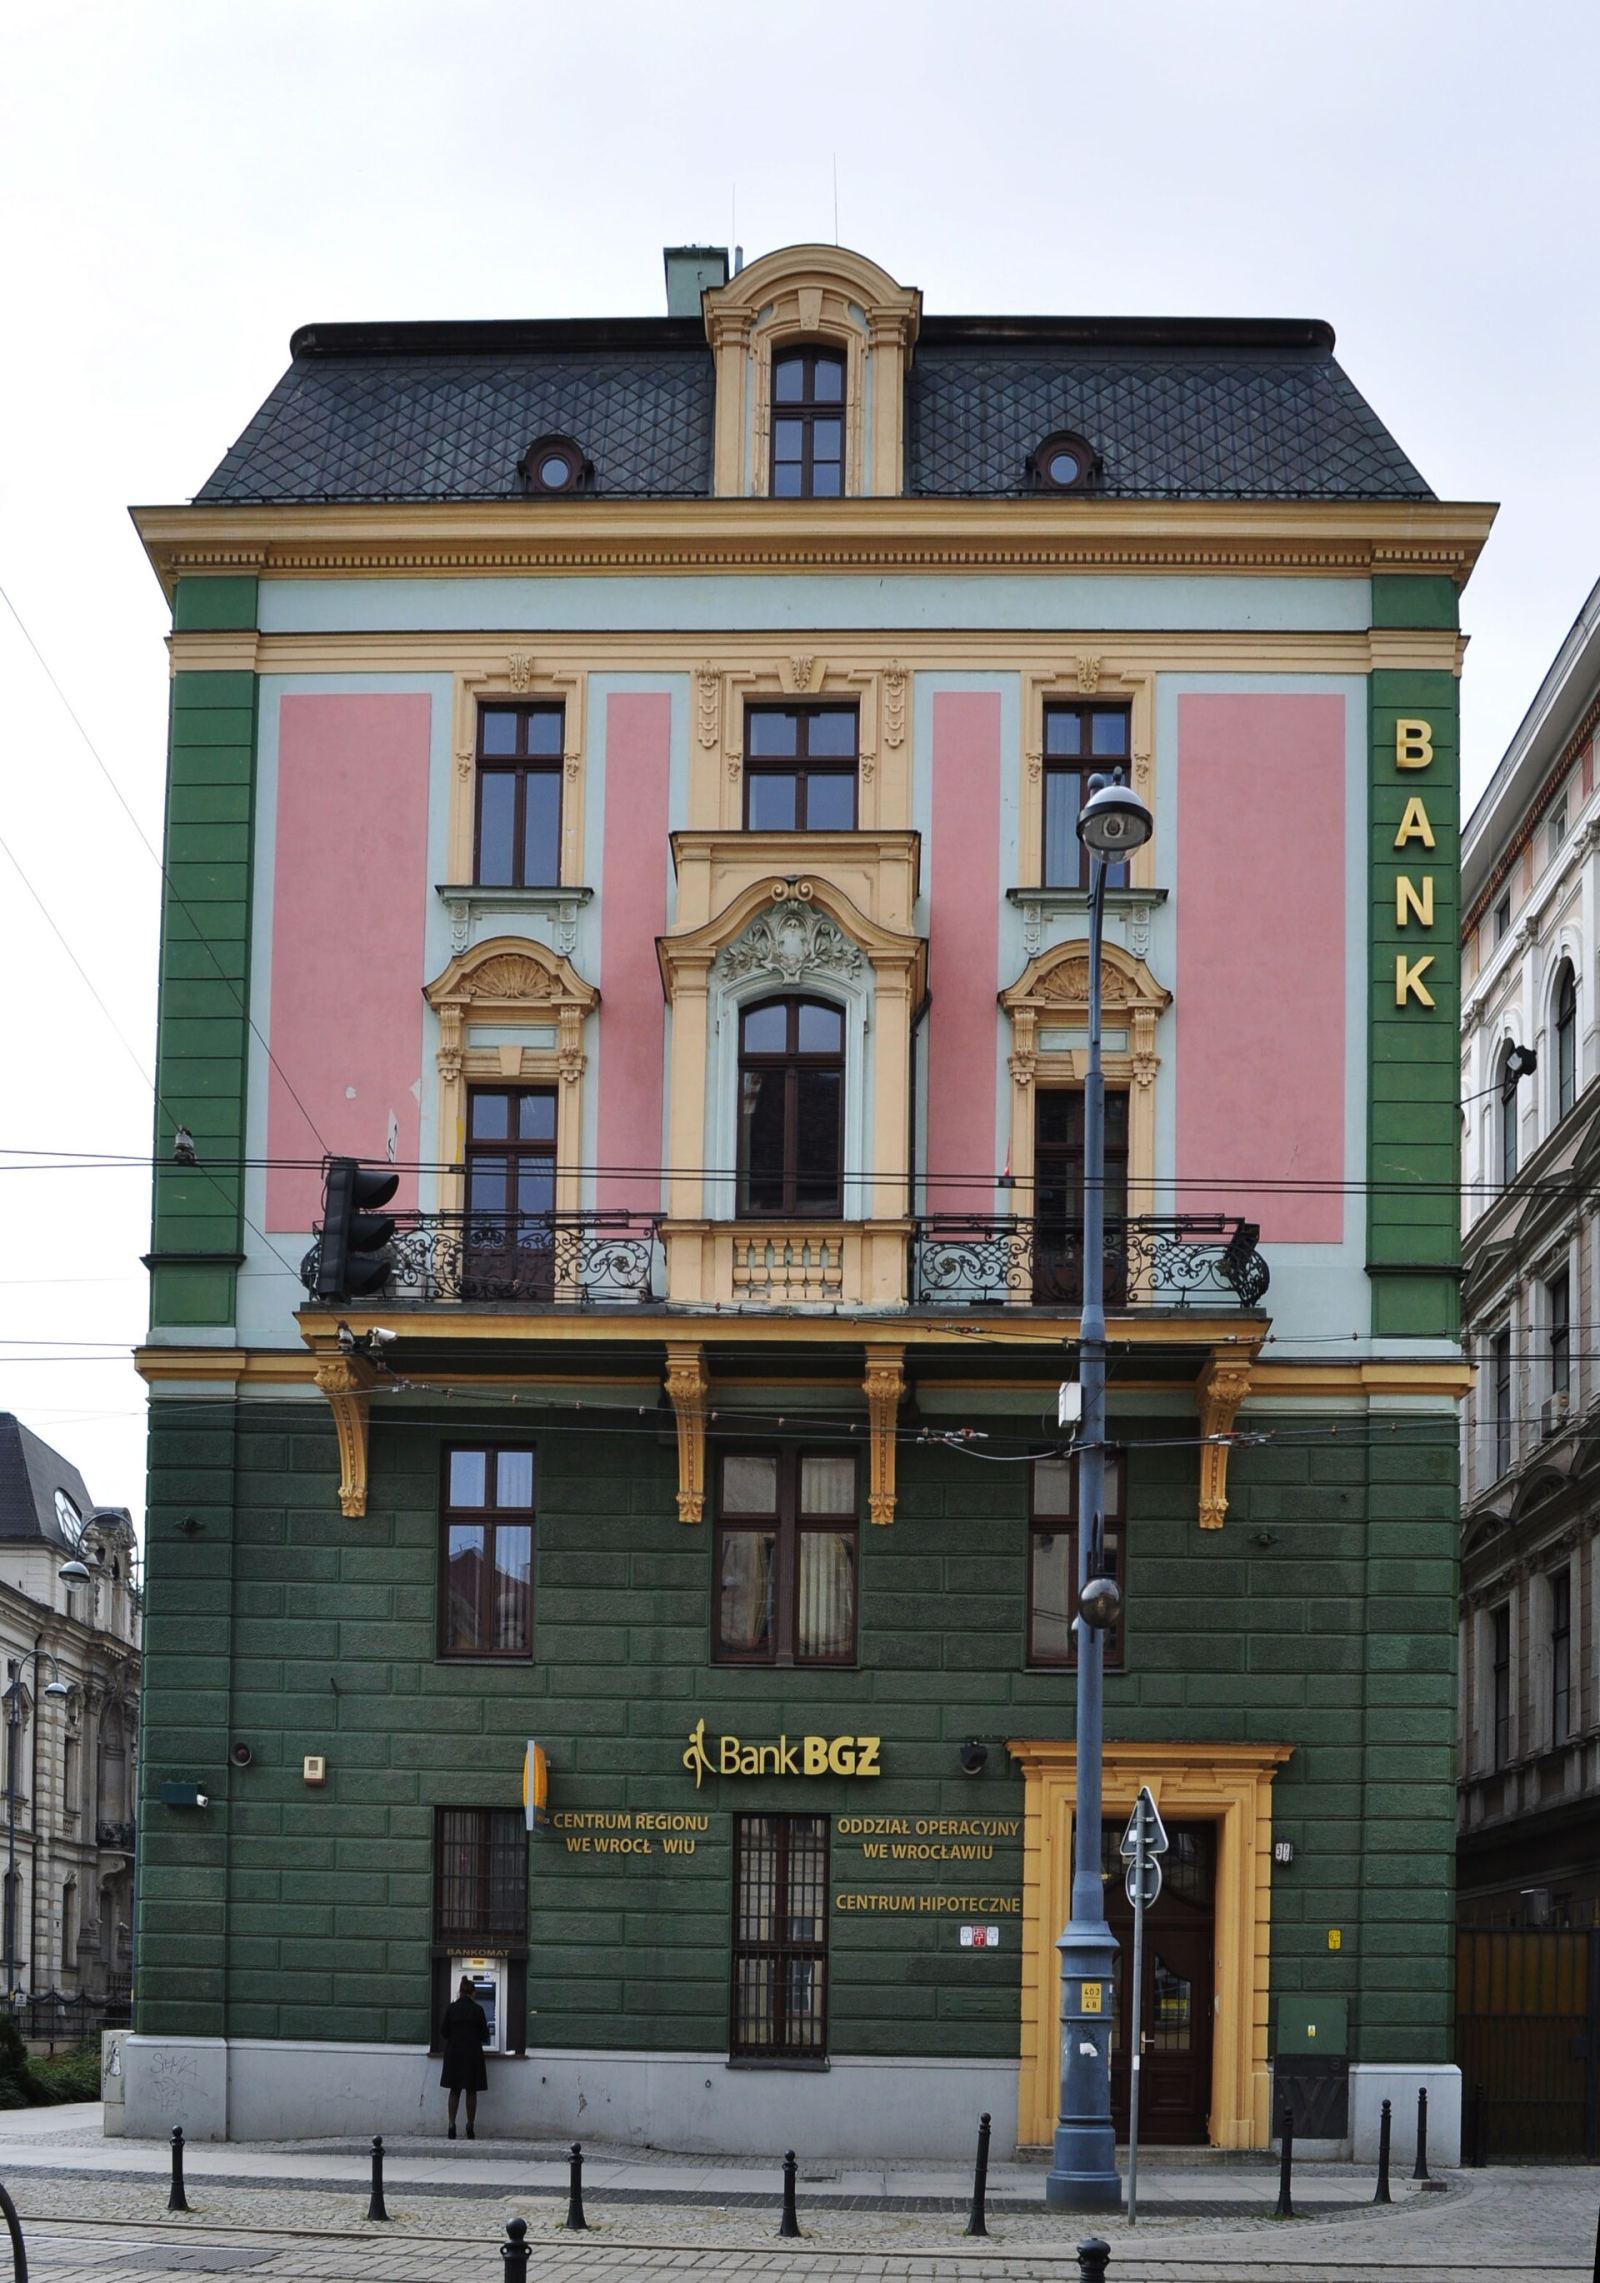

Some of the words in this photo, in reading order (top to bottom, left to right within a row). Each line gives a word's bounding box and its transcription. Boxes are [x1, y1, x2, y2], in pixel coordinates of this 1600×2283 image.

[1394, 718, 1436, 1008] BANK
[720, 1735, 799, 1775] Bank
[553, 1813, 631, 1829] CENTRUM
[635, 1815, 709, 1831] REGIONU
[837, 1818, 911, 1834] ODDZIAŁ
[915, 1819, 1020, 1836] OPERACYJNY
[566, 1837, 591, 1852] WE
[863, 1843, 888, 1859] WE
[891, 1845, 994, 1860] WROCŁAWIU
[836, 1894, 916, 1911] CENTRUM
[919, 1896, 1021, 1913] HIPOTECZNE
[447, 1948, 510, 1957] BANKOMAT
